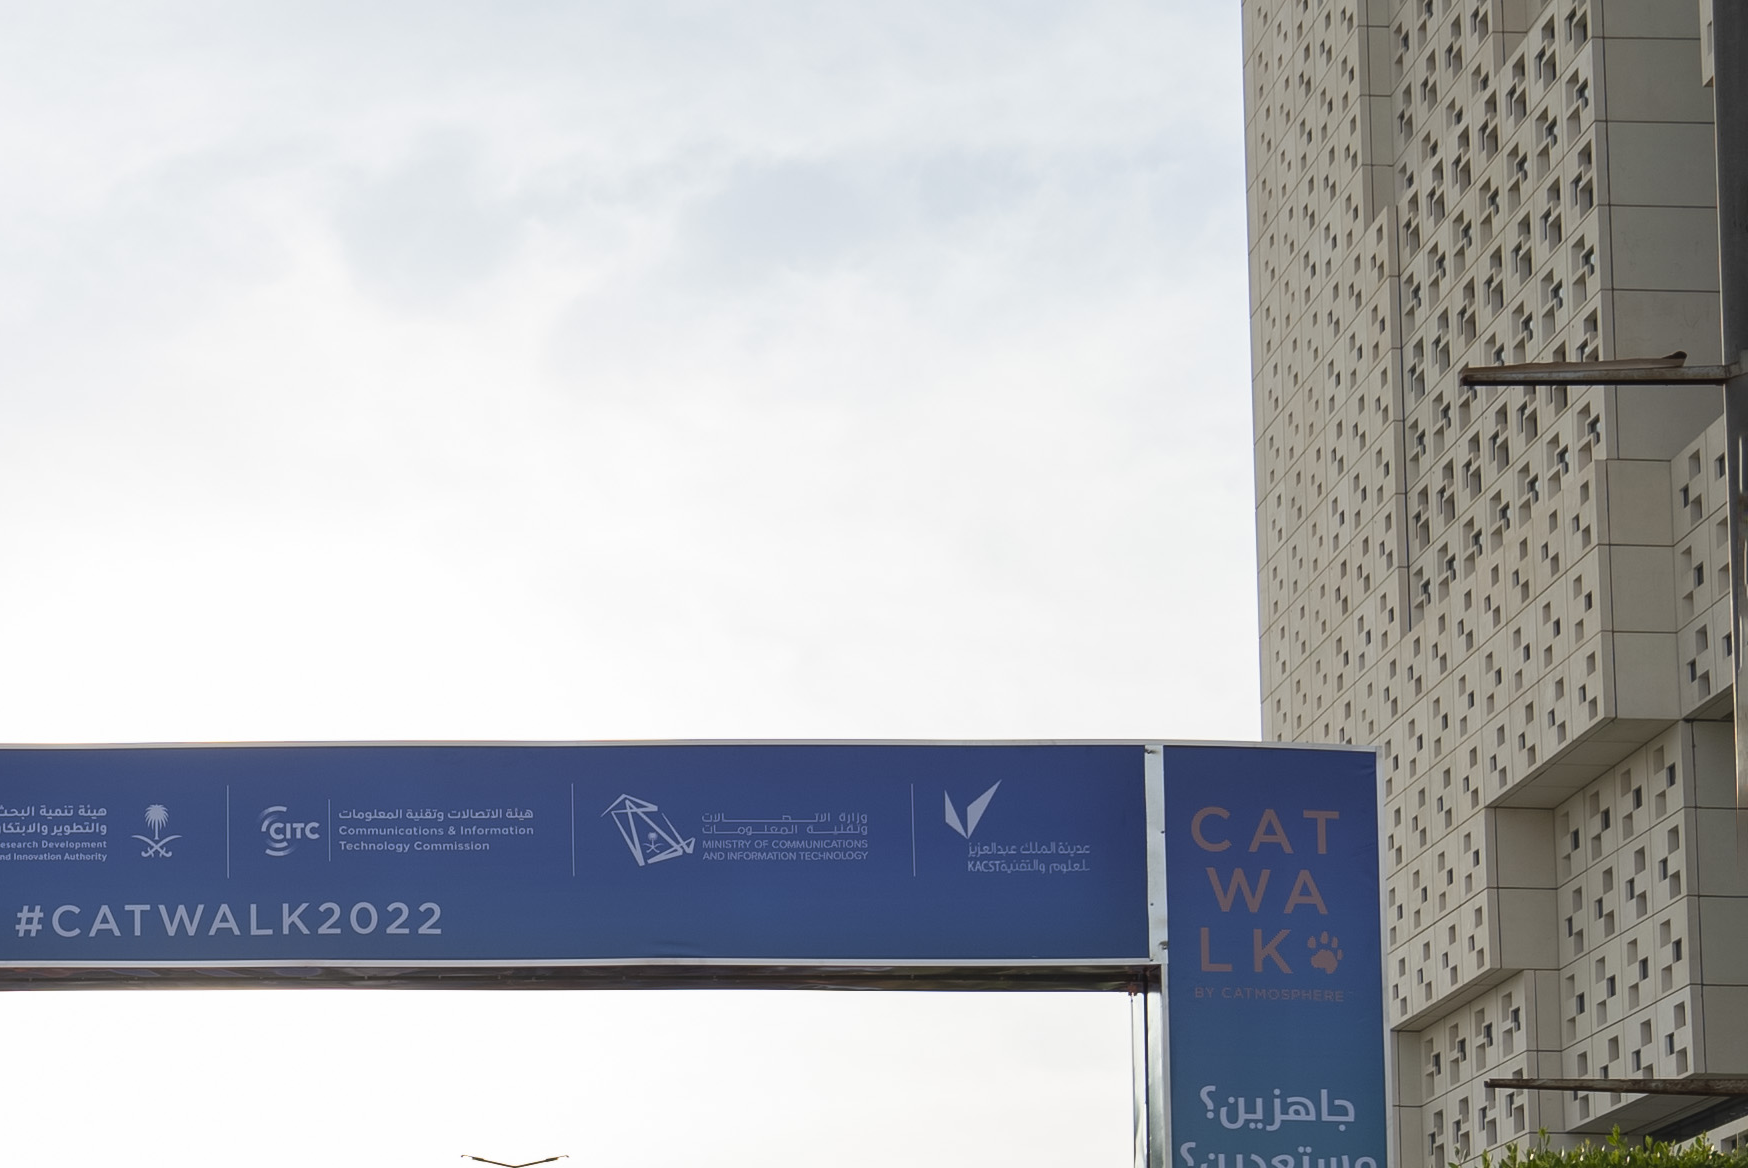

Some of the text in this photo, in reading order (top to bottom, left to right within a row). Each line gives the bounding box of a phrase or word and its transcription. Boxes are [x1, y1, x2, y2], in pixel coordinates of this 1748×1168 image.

[40, 804, 74, 820] تنمية
[78, 804, 107, 819] هيئة
[338, 808, 534, 822] هيئة الاتصالات وتقنية المعلومات
[702, 812, 868, 824] وزارة الاتصالات
[52, 822, 107, 836] والتطوير
[268, 822, 320, 840] CITC
[338, 825, 534, 837] Communications & Information
[702, 823, 868, 836] وتقنية المعلومات
[1190, 806, 1340, 855] CAT
[41, 840, 107, 850] Development
[338, 840, 490, 853] Technology Commission
[702, 840, 868, 849] MINISTRY OF COMMUNICATIONS
[968, 842, 1017, 858] عبدالعزيز
[1020, 842, 1056, 854] الملك
[14, 852, 62, 861] Innovation
[64, 852, 108, 862] Authority
[702, 851, 869, 861] AND INFORMATION TECHNOLOGY
[967, 861, 1001, 872] KACST
[1206, 867, 1328, 915] WA
[15, 901, 443, 937] #CATWALK2022
[1200, 927, 1293, 974] LK
[1194, 986, 1345, 1002] BY CATMOSPHERE
[1199, 1085, 1356, 1132] جاهزين؟
